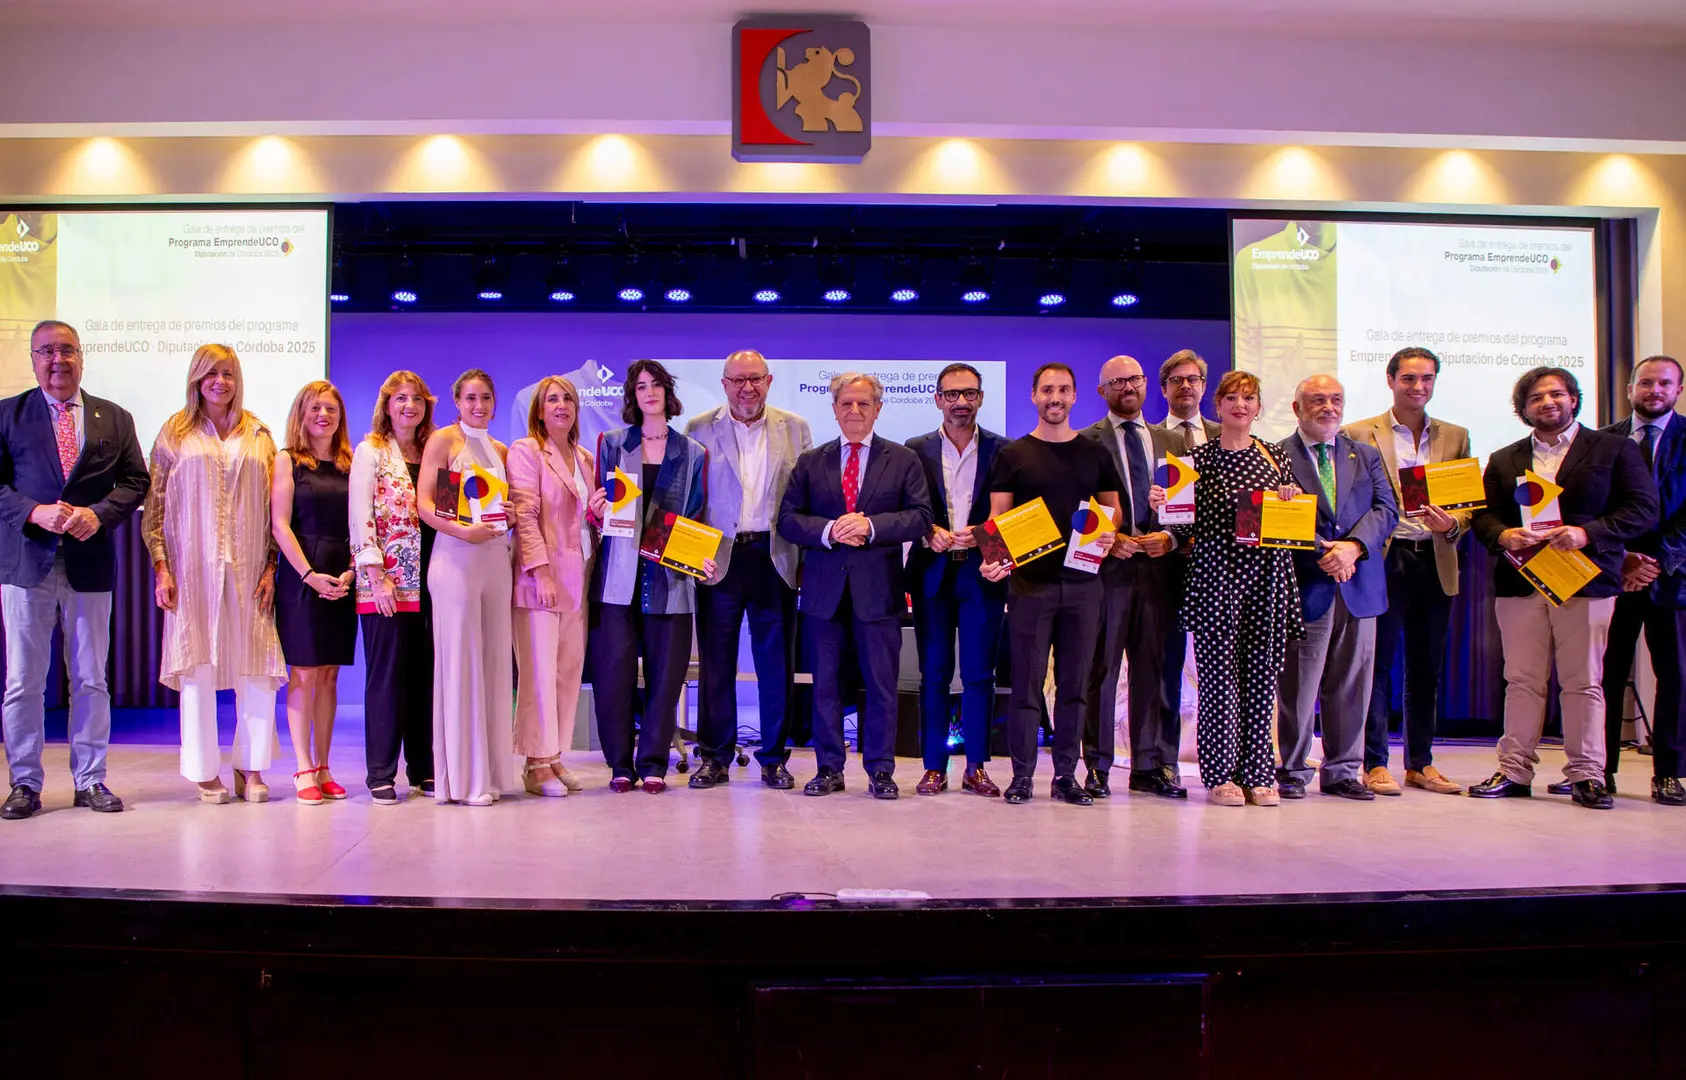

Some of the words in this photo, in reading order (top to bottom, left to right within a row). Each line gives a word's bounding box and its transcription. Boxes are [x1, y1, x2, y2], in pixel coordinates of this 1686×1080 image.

[0, 240, 39, 252] endeUCO
[168, 237, 211, 249] Programa
[214, 237, 279, 249] EmprendeUCO
[1444, 251, 1485, 263] Programa
[1487, 252, 1549, 264] EmprendeUCO
[85, 318, 108, 331] Gala
[111, 318, 124, 331] de
[126, 319, 166, 334] entrega
[168, 318, 182, 331] de
[184, 318, 226, 334] premios
[228, 317, 245, 331] del
[247, 320, 298, 334] programa
[1366, 328, 1390, 341] Gala
[1391, 329, 1404, 341] de
[1407, 330, 1445, 345] entrega
[1446, 330, 1460, 343] de
[1462, 331, 1501, 345] premios
[1503, 332, 1519, 345] del
[1520, 333, 1567, 348] programa
[81, 339, 150, 355] prendeUCO
[287, 340, 316, 353] 2025
[1350, 349, 1391, 365] Empren
[1437, 351, 1494, 366] Diputación
[1495, 353, 1509, 365] de
[1557, 355, 1584, 368] 2025
[868, 370, 899, 382] trega
[902, 371, 915, 381] de
[577, 385, 625, 397] ndeUCO
[885, 383, 937, 394] rendeUC
[924, 396, 935, 405] 20
